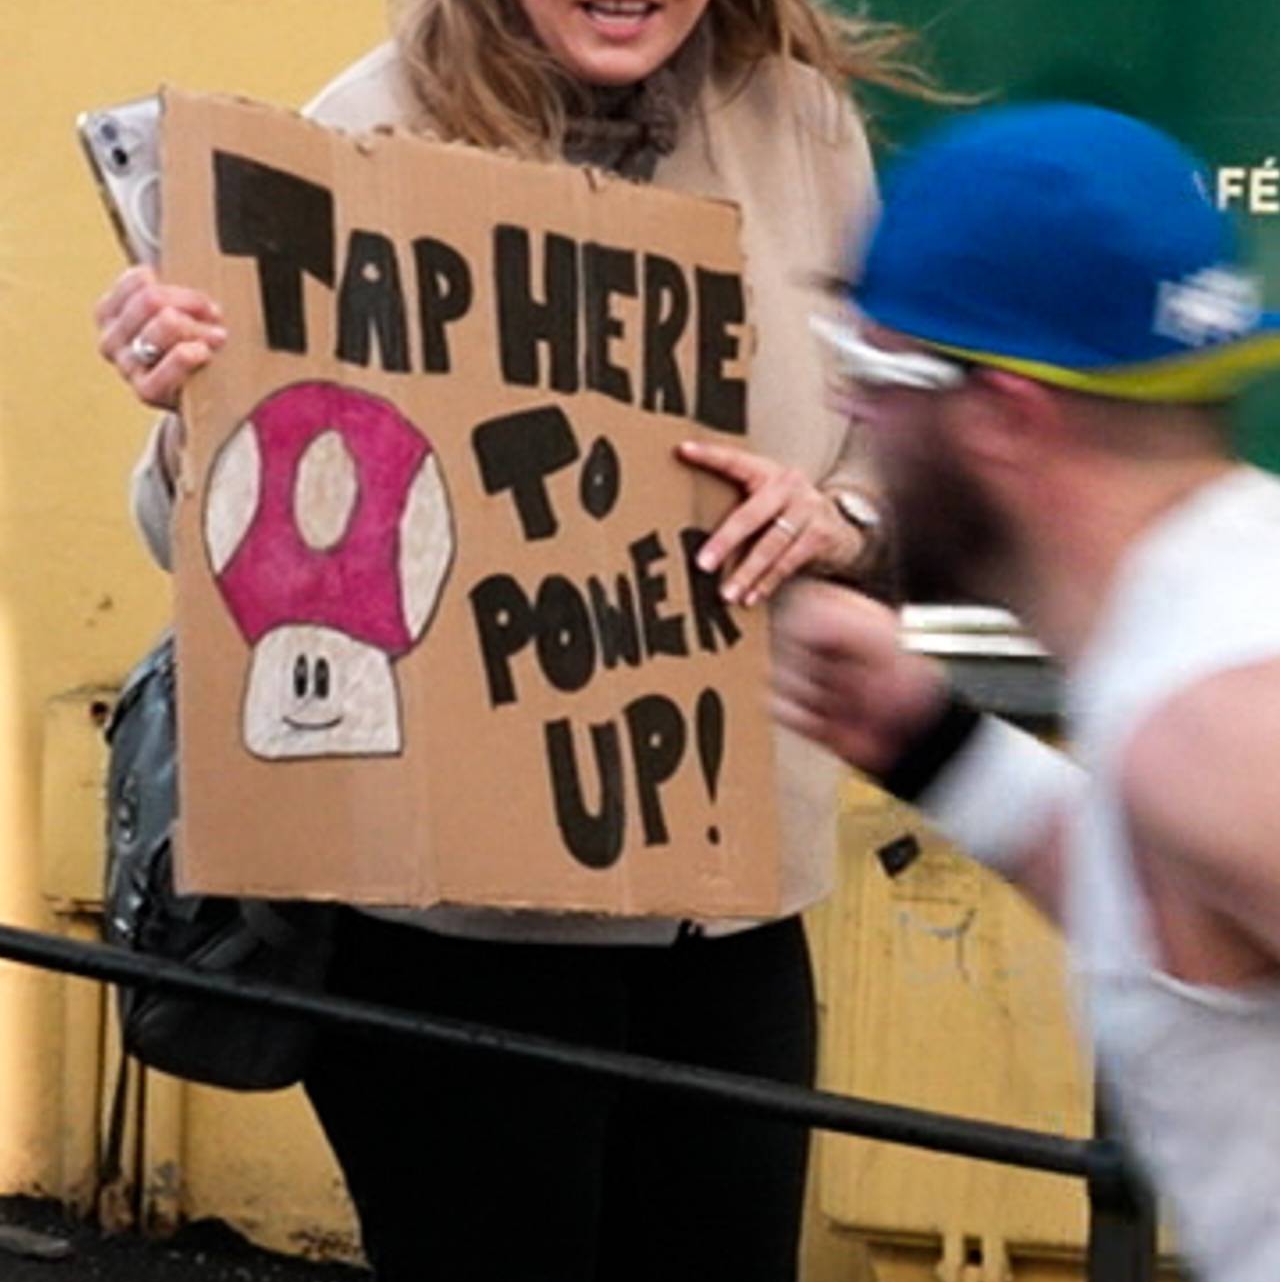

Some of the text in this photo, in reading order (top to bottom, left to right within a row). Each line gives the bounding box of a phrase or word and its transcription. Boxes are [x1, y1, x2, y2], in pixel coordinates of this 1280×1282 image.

[212, 148, 747, 435] TAP HERE
[471, 404, 620, 542] TO
[468, 527, 742, 710] POWER
[543, 686, 726, 870] UP!
